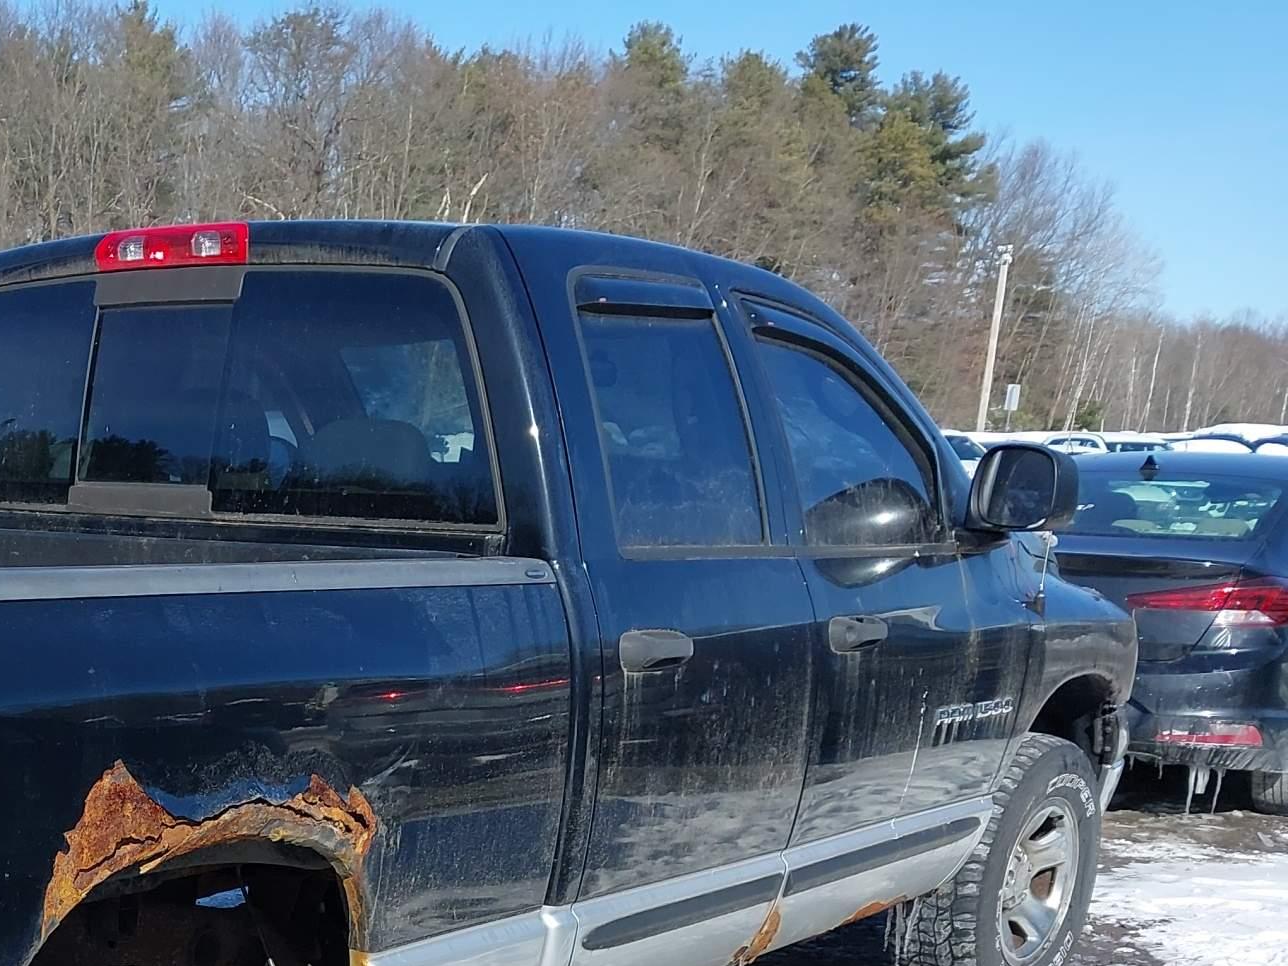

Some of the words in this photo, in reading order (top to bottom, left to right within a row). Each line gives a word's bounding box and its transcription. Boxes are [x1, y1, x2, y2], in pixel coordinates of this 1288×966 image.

[935, 703, 974, 726] RAM
[974, 697, 1014, 719] 1500
[1046, 773, 1095, 817] COOPER
